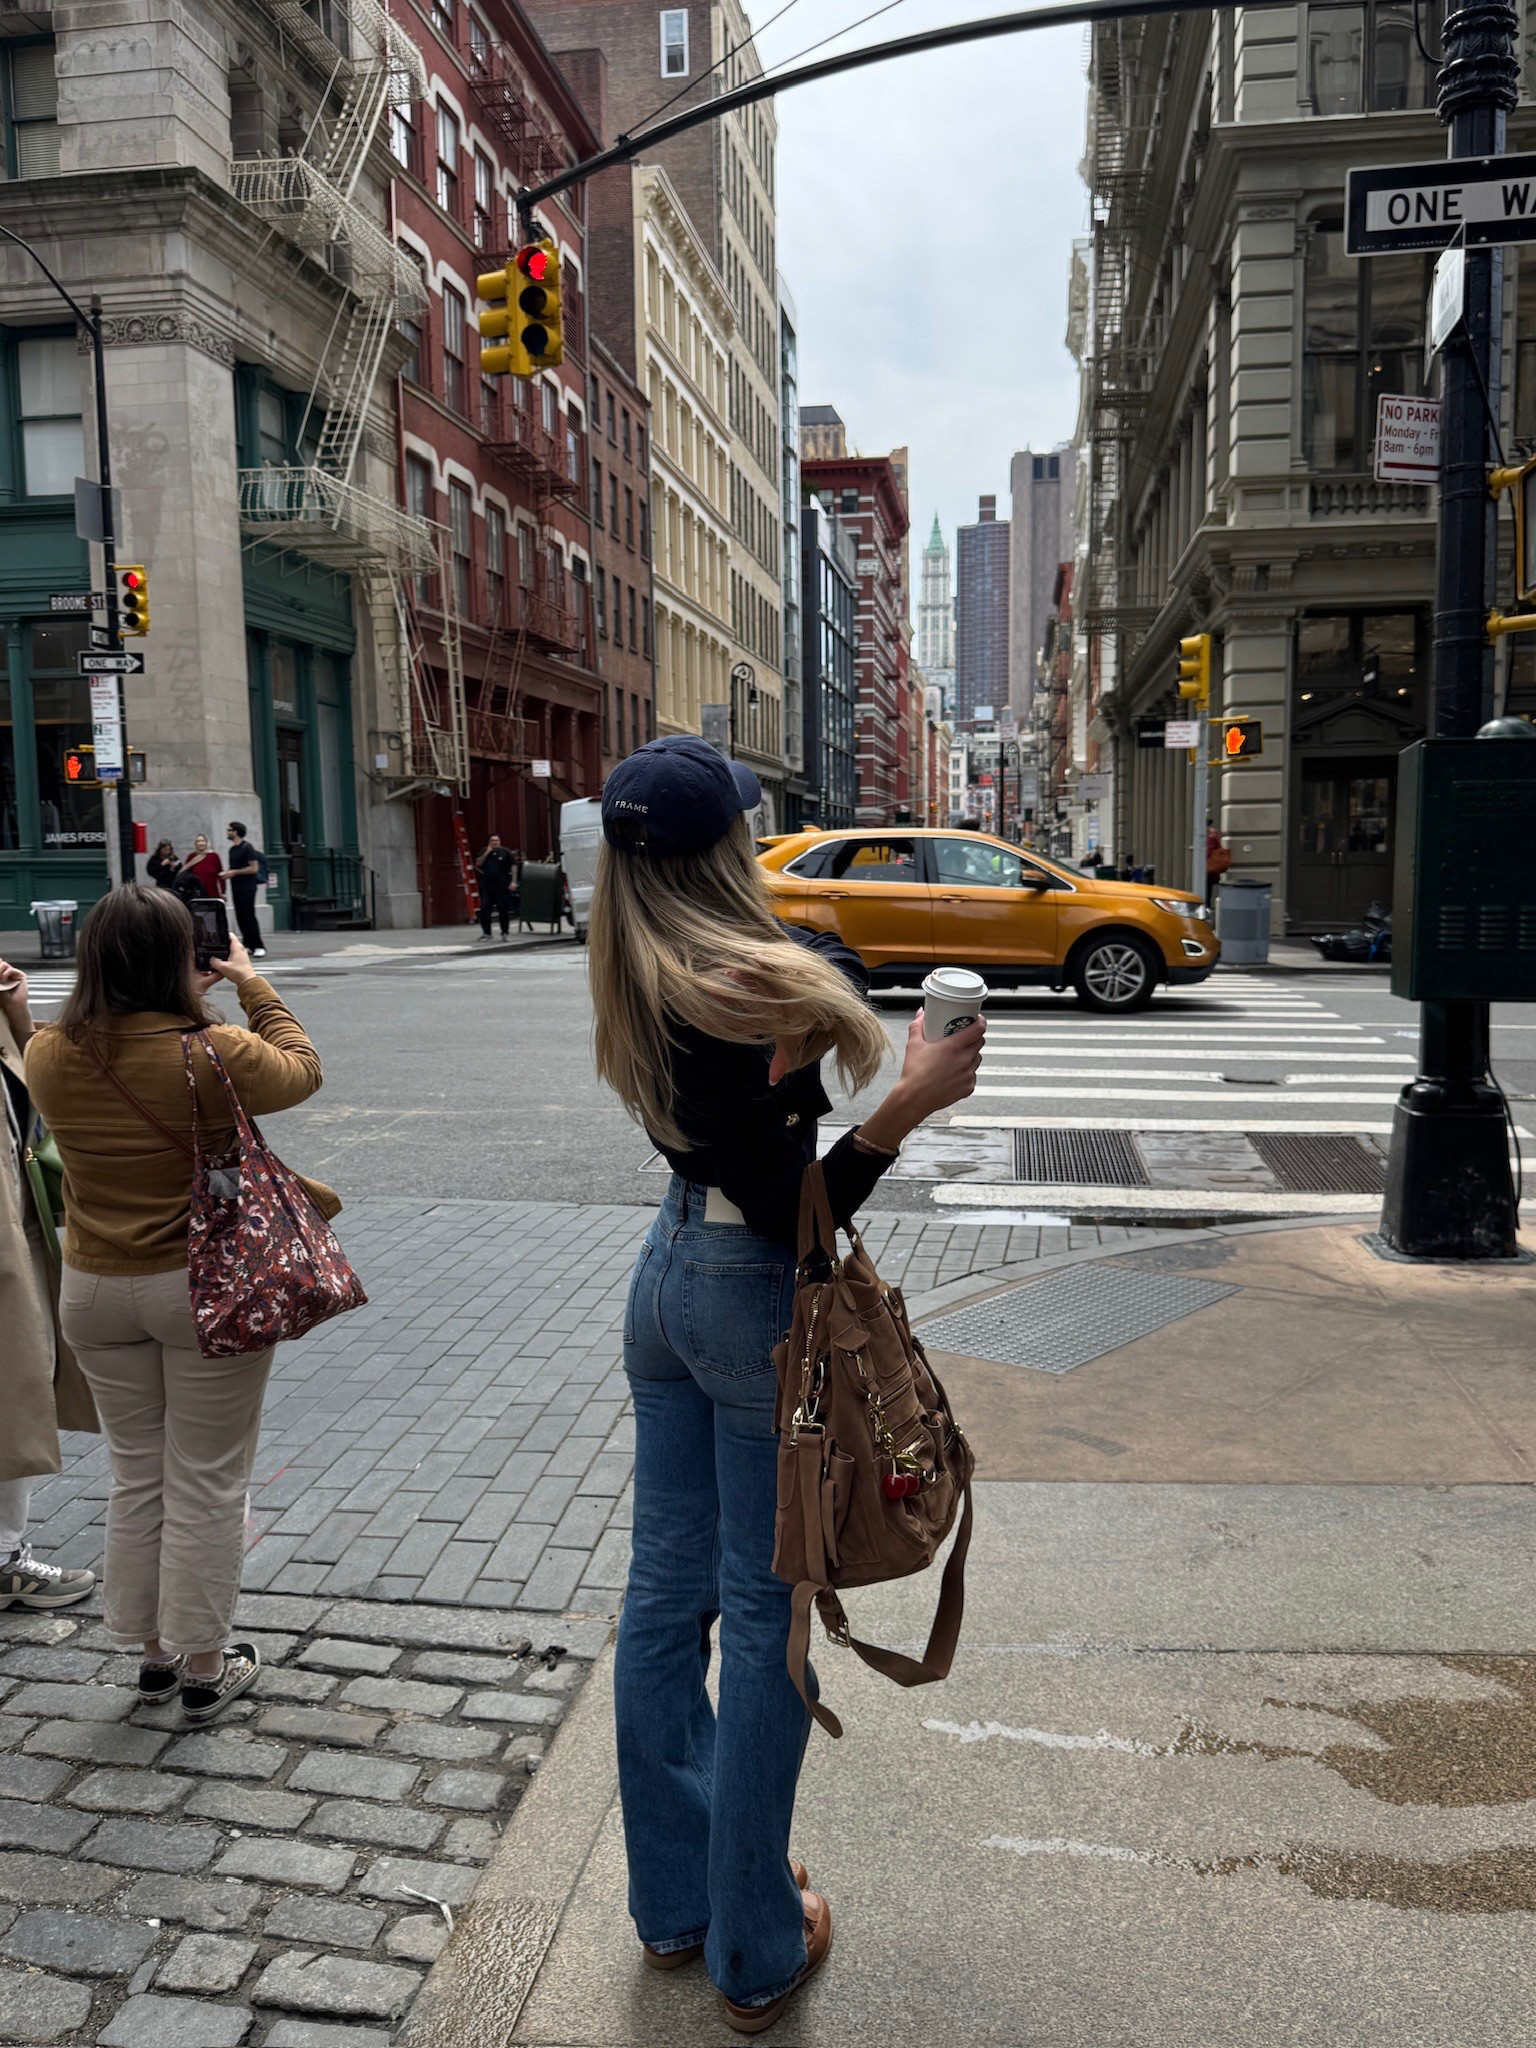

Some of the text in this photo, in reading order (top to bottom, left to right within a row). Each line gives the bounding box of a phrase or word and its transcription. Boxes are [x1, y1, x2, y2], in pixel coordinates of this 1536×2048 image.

[1388, 183, 1536, 225] ONE W
[1386, 405, 1402, 420] NO
[1384, 425, 1420, 441] Monday
[1384, 441, 1403, 453] 8am
[1413, 443, 1434, 457] 6pm
[51, 595, 103, 611] BROOME ST
[88, 659, 135, 668] ONE WAY
[615, 800, 649, 814] FRAME
[44, 831, 107, 844] JAMES PERS
